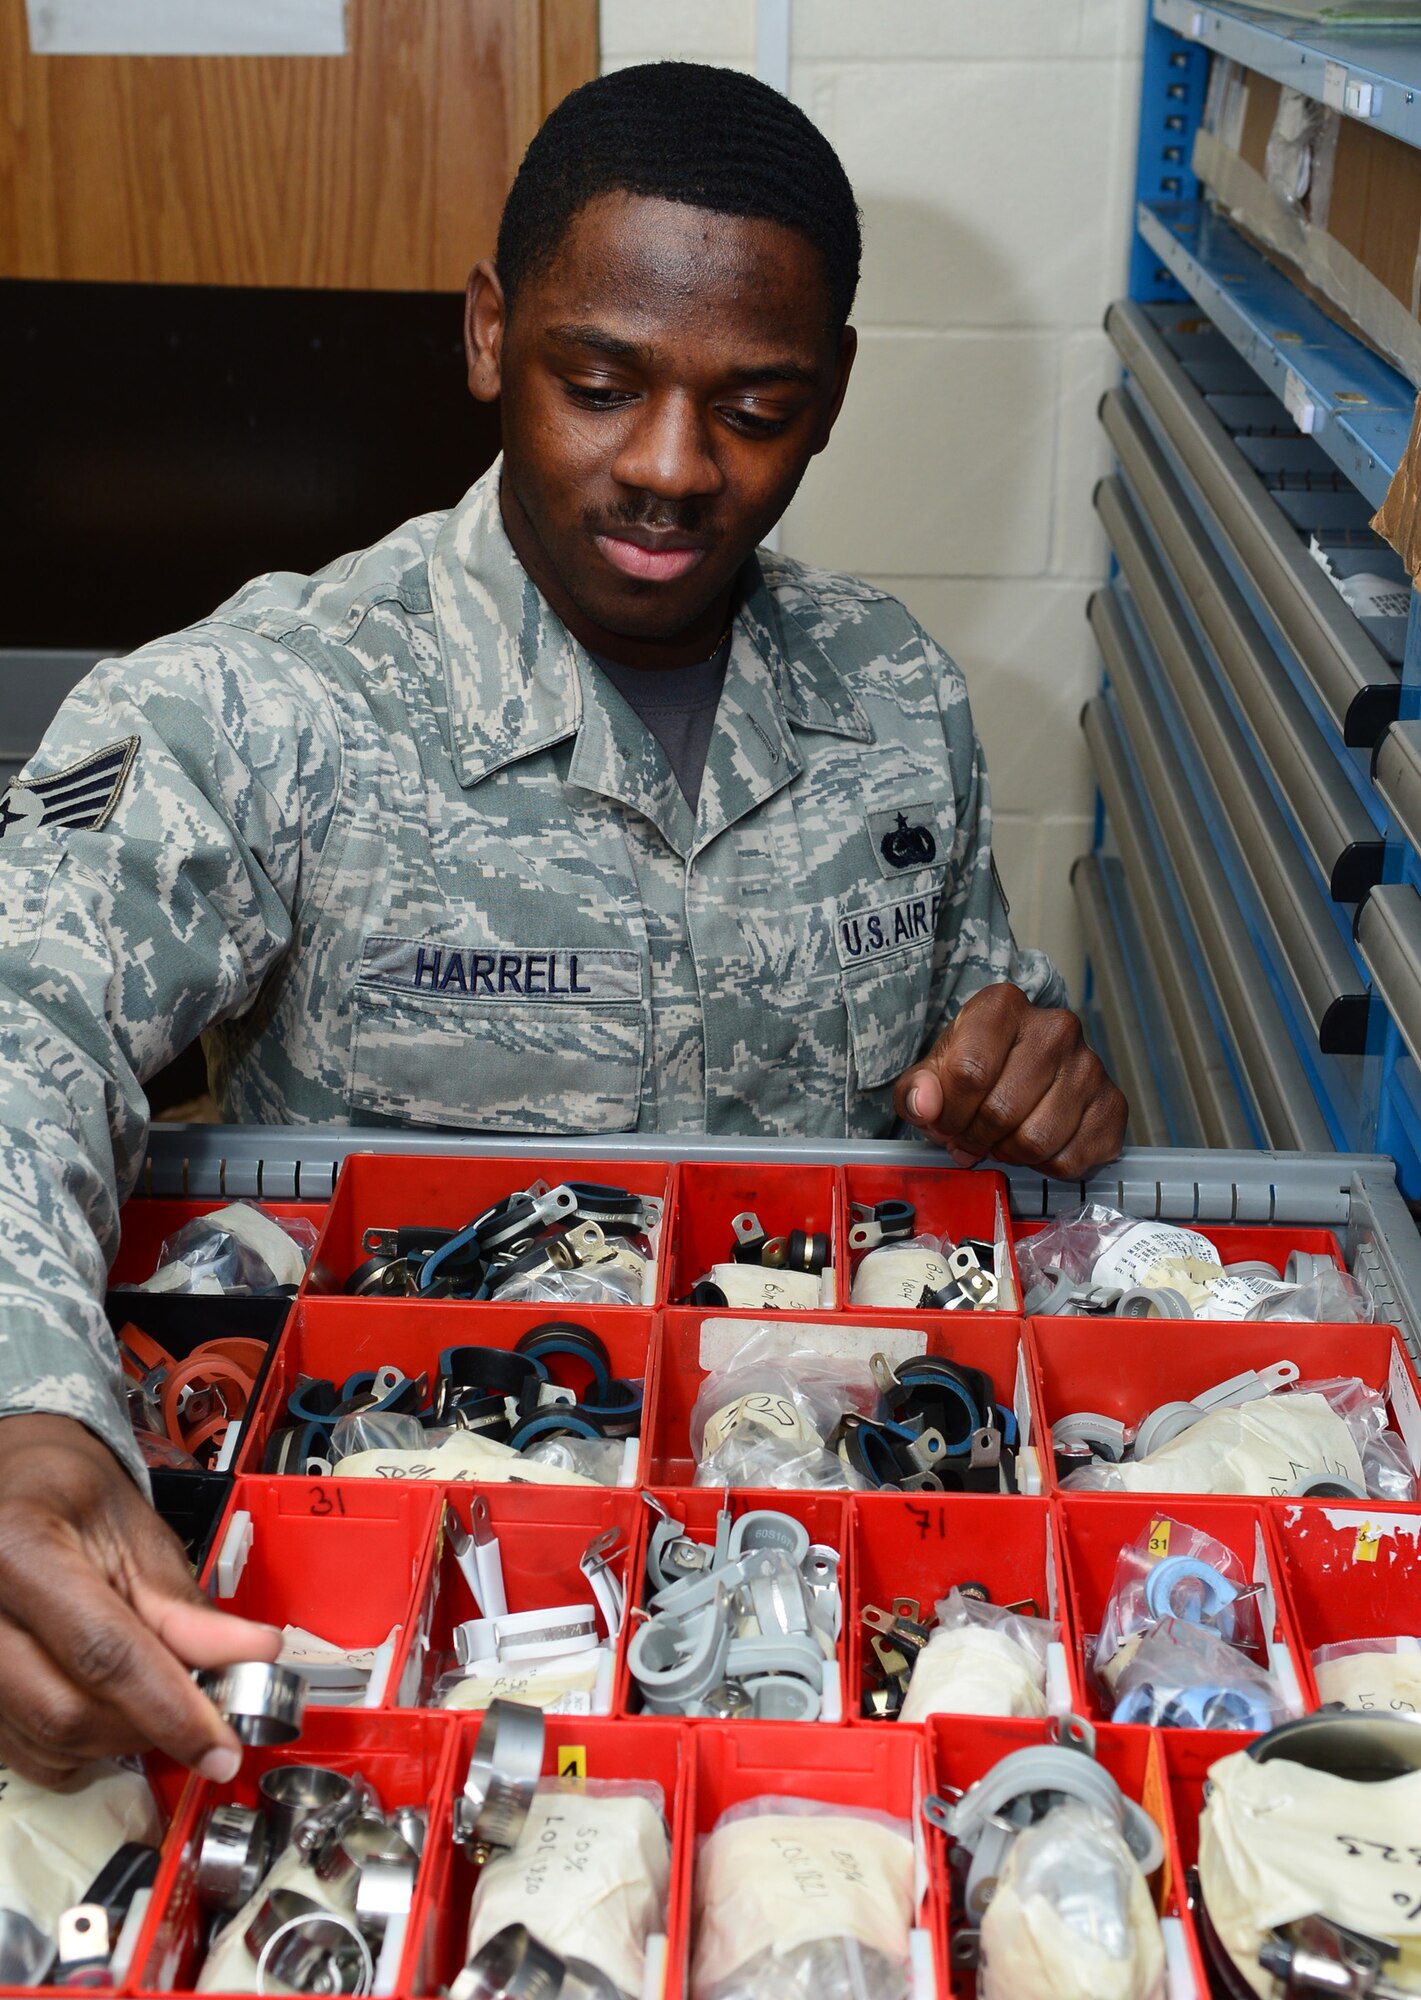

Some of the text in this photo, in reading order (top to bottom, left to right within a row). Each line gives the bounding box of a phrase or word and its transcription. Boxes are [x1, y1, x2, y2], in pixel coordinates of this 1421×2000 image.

[842, 915, 890, 956] U.S.
[894, 900, 930, 944] AIR
[414, 947, 592, 994] HARRELL
[309, 1485, 346, 1517] 31
[1149, 1537, 1168, 1550] 31
